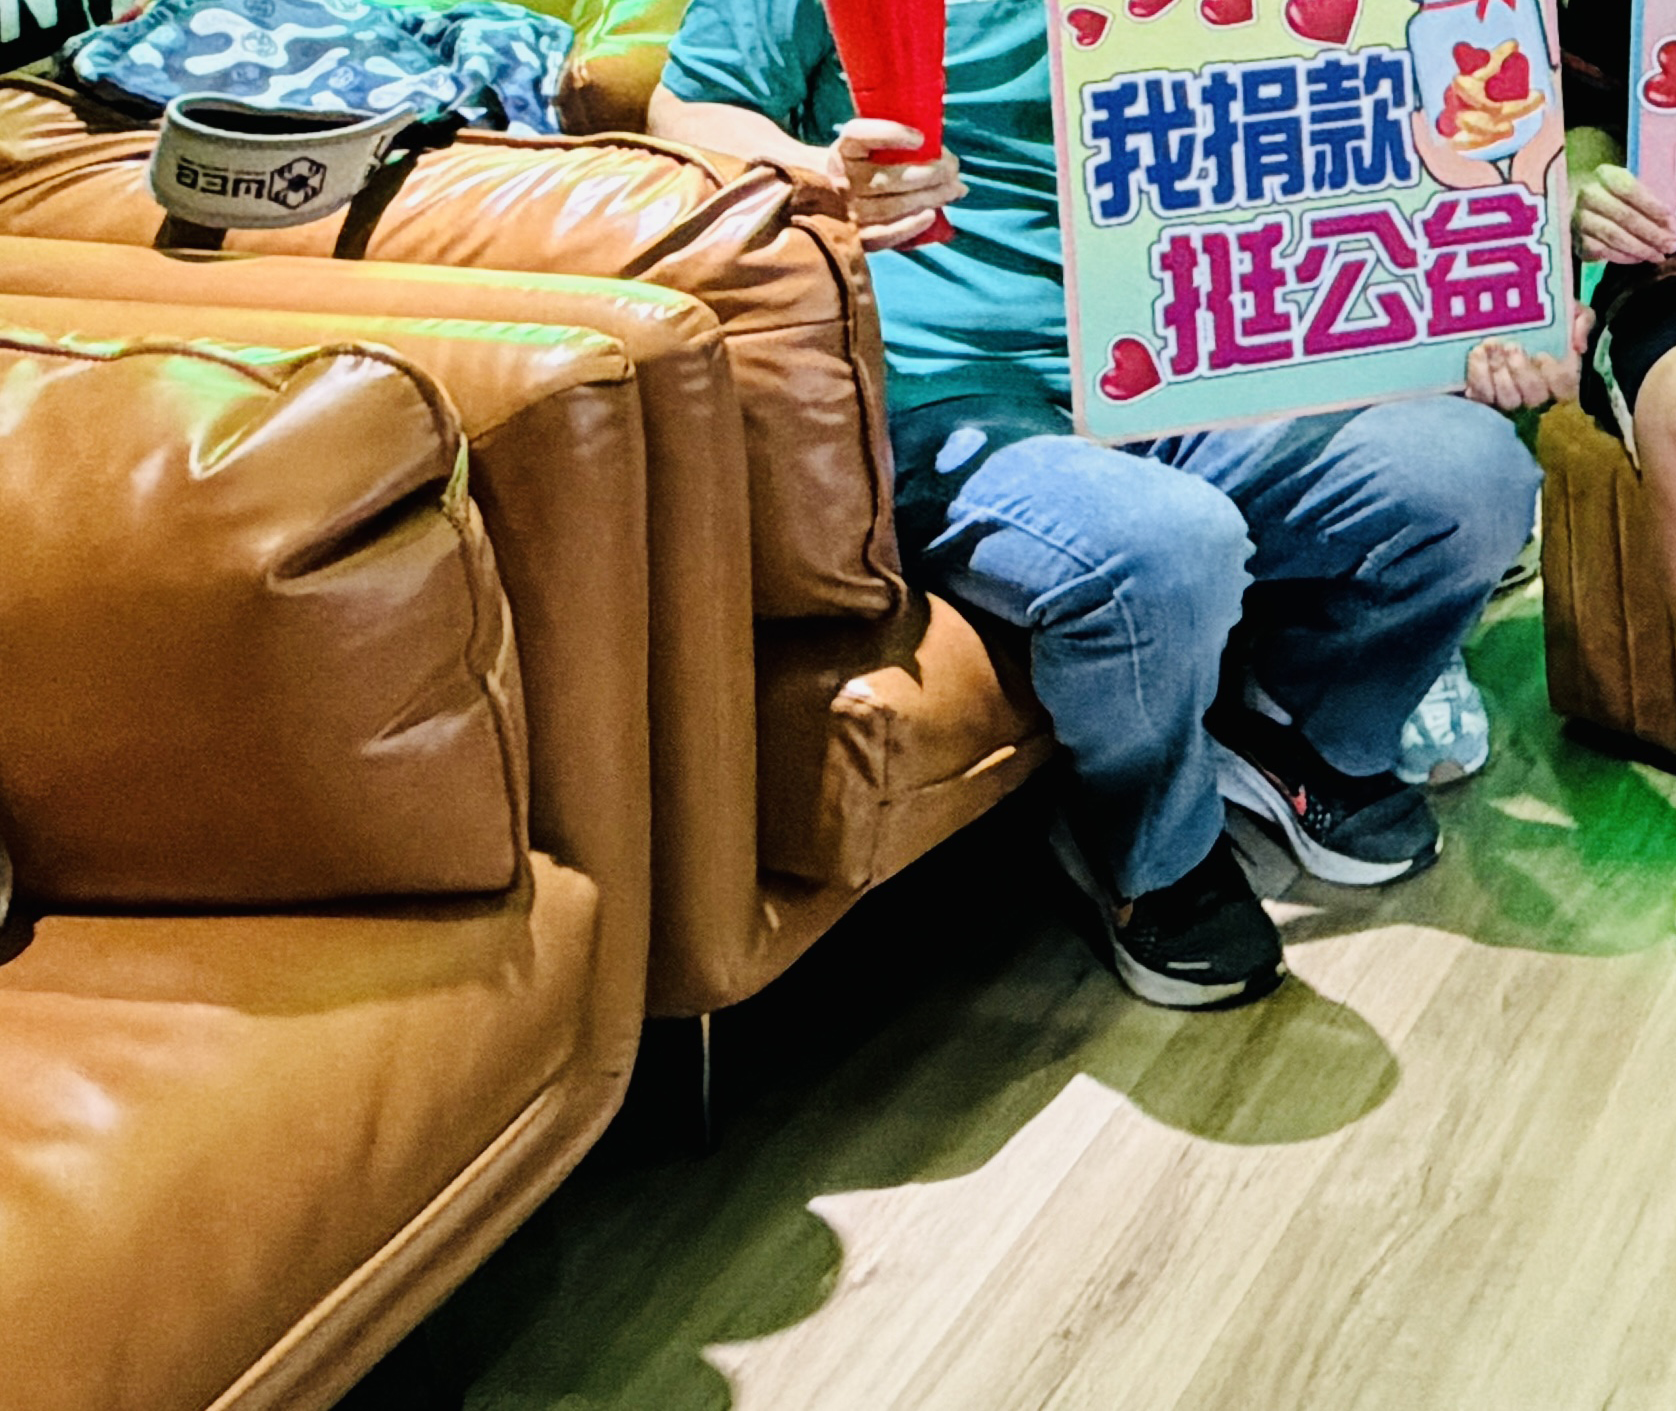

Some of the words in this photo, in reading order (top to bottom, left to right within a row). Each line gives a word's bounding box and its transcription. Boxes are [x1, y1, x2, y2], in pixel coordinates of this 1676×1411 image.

[1090, 51, 1411, 220] 我捐款
[1159, 192, 1548, 376] 挺公益
